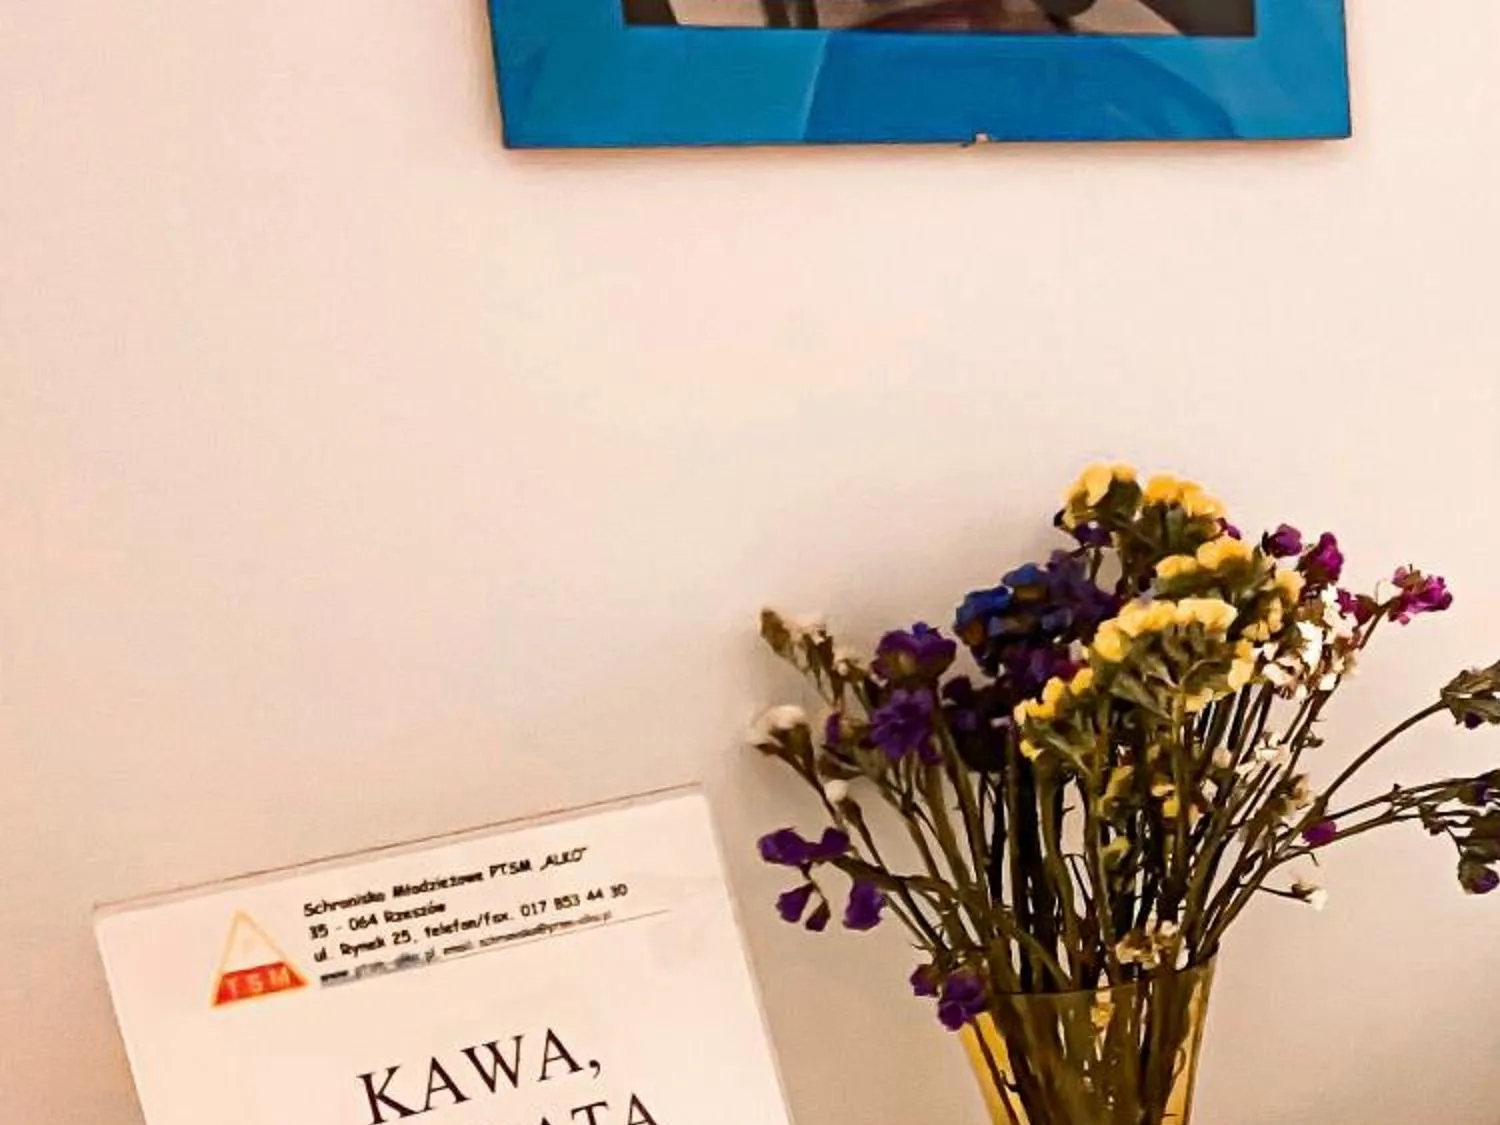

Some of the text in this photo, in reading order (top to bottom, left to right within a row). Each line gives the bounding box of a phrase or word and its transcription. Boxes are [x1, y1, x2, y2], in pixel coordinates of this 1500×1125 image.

[489, 858, 532, 878] PTSM
[339, 936, 385, 957] Rynek
[520, 900, 547, 918] 017
[586, 887, 605, 901] 44
